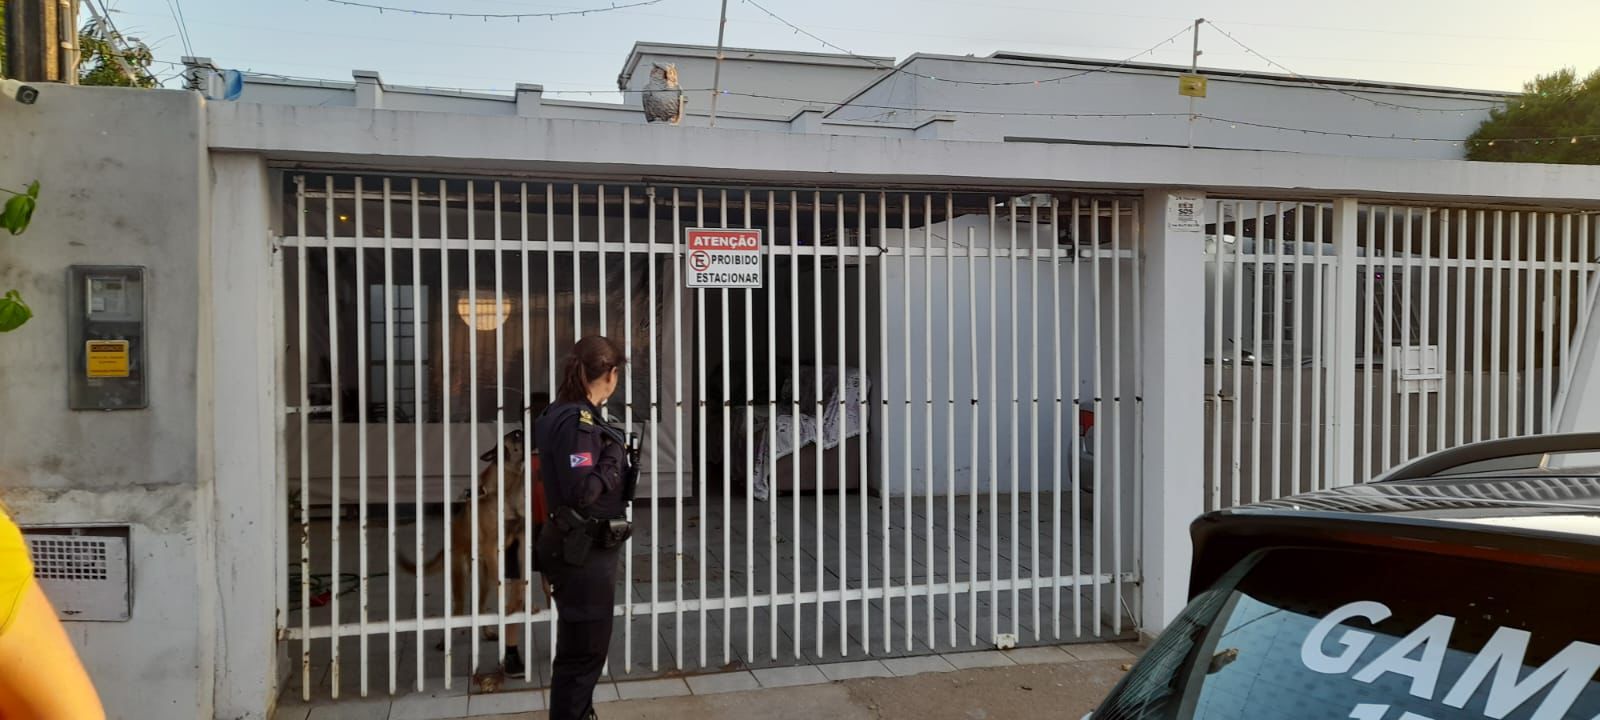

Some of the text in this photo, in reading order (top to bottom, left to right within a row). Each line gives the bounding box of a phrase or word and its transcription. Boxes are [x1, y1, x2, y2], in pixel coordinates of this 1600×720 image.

[694, 234, 757, 249] ATENÇÃO
[711, 255, 758, 265] PROIBIDO
[696, 273, 758, 283] ESTACIONAR
[1301, 600, 1600, 720] GAM
